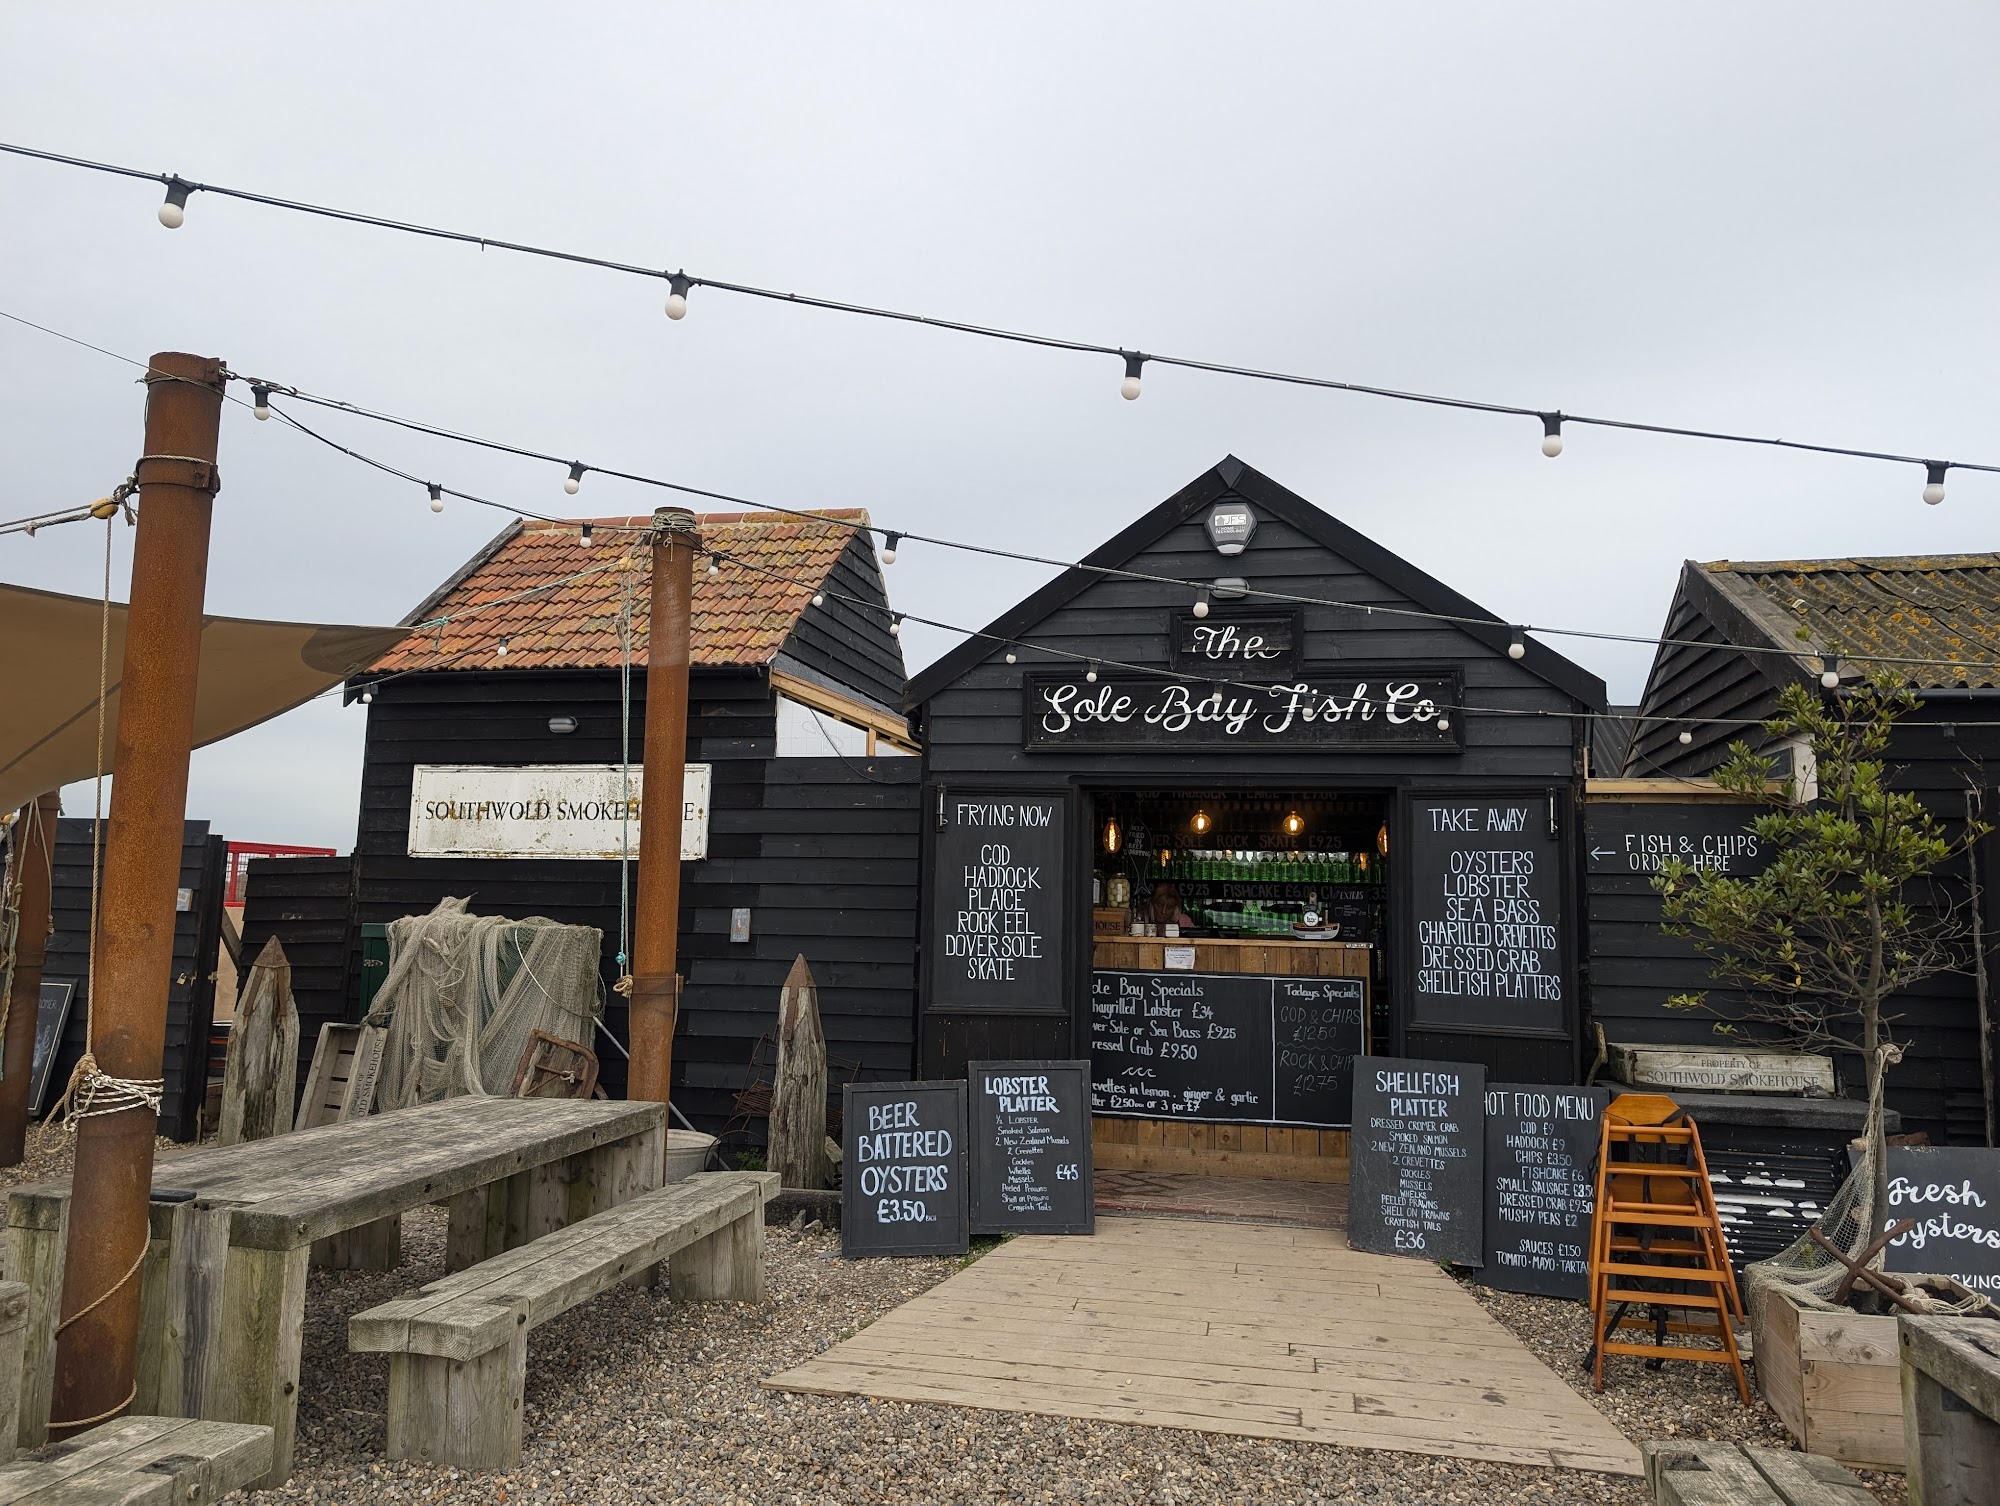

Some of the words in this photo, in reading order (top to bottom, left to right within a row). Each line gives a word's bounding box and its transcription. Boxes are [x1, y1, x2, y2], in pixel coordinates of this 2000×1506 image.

[1225, 516, 1246, 524] JFS
[1192, 626, 1281, 659] The
[1042, 684, 1138, 734] Sole
[1145, 685, 1256, 735] Bay
[1264, 682, 1377, 733] Fish
[426, 801, 550, 820] SOUTHWOLD
[557, 801, 694, 821] SMOKEHE
[957, 804, 1014, 826] FRYING
[1019, 806, 1052, 826] NOW
[1428, 808, 1479, 832] TAKE
[1486, 808, 1528, 832] AWAY
[1174, 834, 1204, 848] SOLE
[1216, 835, 1248, 848] ROCK
[1260, 835, 1298, 848] SKATE
[1625, 834, 1672, 853] FISH
[1680, 836, 1694, 853] &
[1703, 835, 1758, 856] CHIPS
[981, 844, 1010, 866] COD
[1450, 851, 1534, 874] OYSTERS
[1693, 854, 1730, 872] HERE
[964, 866, 1041, 889] HADDOCK
[1444, 874, 1530, 898] LOBSTER
[968, 888, 1026, 910] PLAICE
[1223, 884, 1281, 898] FISHCAKE
[1446, 898, 1486, 922] SEA
[1494, 899, 1540, 924] BASS
[957, 911, 999, 933] ROCK
[1004, 912, 1035, 935] EEL
[1419, 921, 1491, 946] CHARILLED
[1494, 924, 1556, 950] CREVETTES
[945, 934, 998, 956] DOVER
[1002, 936, 1042, 958] SOLE
[1422, 945, 1494, 972] DRESSED
[1497, 950, 1541, 973] CRAB
[967, 958, 1016, 980] SKATE
[1120, 977, 1144, 1000] Bay
[1151, 978, 1204, 1006] Specials
[1284, 984, 1320, 1000] Todays
[1322, 984, 1360, 1002] Specials
[1418, 970, 1490, 996] SHELLFISH
[1495, 973, 1561, 1000] PLATTERS
[1144, 999, 1183, 1018] Lobster
[1192, 1002, 1214, 1020] £34
[1280, 1006, 1306, 1023] COD
[1310, 1010, 1318, 1024] &
[1322, 1008, 1360, 1024] CHIPS
[1110, 1020, 1130, 1034] Sole
[1134, 1026, 1146, 1036] or
[1149, 1020, 1168, 1037] Sea
[1172, 1021, 1201, 1038] Bass
[1092, 1036, 1124, 1052] ressed
[1130, 1037, 1154, 1056] Crab
[1160, 1042, 1198, 1060] £9.50
[364, 1036, 384, 1097] SMOKEHOUSE
[1280, 1050, 1317, 1070] ROCK
[1320, 1055, 1329, 1072] &
[1330, 1054, 1354, 1070] CHIP
[1701, 1060, 1746, 1068] PROPERTY
[1749, 1061, 1761, 1069] OF
[985, 1076, 1050, 1094] LOBSTER
[1376, 1070, 1460, 1096] SHELLFISH
[1646, 1071, 1726, 1084] SOUTHWOLD
[1730, 1074, 1818, 1088] SMOKEHOUSE
[1130, 1084, 1139, 1095] in
[1183, 1087, 1212, 1102] ginger
[1215, 1088, 1226, 1102] &
[1230, 1091, 1258, 1106] garlic
[999, 1096, 1060, 1113] PLATTER
[1147, 1099, 1157, 1108] or
[1161, 1100, 1168, 1111] 3
[1172, 1102, 1186, 1113] for
[1390, 1098, 1448, 1118] PLATTER
[1515, 1092, 1550, 1118] FOOD
[1555, 1095, 1594, 1120] MENU
[868, 1101, 920, 1132] BEER
[1370, 1118, 1404, 1130] DRESSED
[1408, 1120, 1436, 1132] CROMER
[1440, 1122, 1460, 1132] CRAB
[998, 1126, 1023, 1136] Smoked
[1027, 1126, 1050, 1134] Salmon
[1389, 1131, 1418, 1143] SMOKED
[1423, 1134, 1448, 1144] SALMON
[1520, 1121, 1536, 1134] COD
[1543, 1122, 1554, 1136] £9
[858, 1130, 952, 1162] BATTERED
[996, 1137, 1002, 1146] 2
[1004, 1138, 1018, 1146] New
[1020, 1136, 1046, 1145] Zealand
[1046, 1136, 1070, 1144] Mussels
[1371, 1141, 1378, 1152] 2
[1378, 1142, 1395, 1152] NEW
[1399, 1142, 1432, 1156] ZEALAND
[1434, 1146, 1467, 1158] MUSSELS
[1506, 1135, 1548, 1150] HADDOCK
[1552, 1138, 1566, 1152] £9
[1015, 1146, 1044, 1155] Crevettes
[1516, 1150, 1542, 1164] CHIPS
[1547, 1152, 1572, 1166] £3.50
[1012, 1157, 1034, 1166] Cockles
[1392, 1156, 1400, 1166] 2
[1402, 1156, 1446, 1170] CREVETTES
[860, 1164, 948, 1196] OYSTERS
[1008, 1176, 1034, 1184] Mussels
[1056, 1164, 1079, 1180] £45
[1400, 1168, 1431, 1180] COCKLES
[1522, 1166, 1568, 1180] FISHCAKE
[1572, 1170, 1584, 1182] £6
[1002, 1183, 1020, 1192] Peeled
[1024, 1183, 1048, 1192] Prawns
[1400, 1179, 1432, 1191] MUSSELS
[1496, 1177, 1529, 1192] SMALL
[1532, 1180, 1570, 1196] SAUSAGE
[1888, 1177, 1986, 1208] Fresh
[1002, 1193, 1018, 1203] Shell
[1381, 1194, 1406, 1206] PEELED
[1409, 1198, 1438, 1210] PRAWNS
[1400, 1189, 1426, 1200] WHELKS
[1500, 1192, 1544, 1208] DRESSED
[1546, 1196, 1566, 1210] CRAB
[1569, 1199, 1593, 1214] £9.50
[877, 1198, 926, 1223] £3.50
[1008, 1202, 1034, 1212] Crayfish
[1036, 1202, 1052, 1211] Tails
[1381, 1205, 1404, 1216] SHELL
[1406, 1208, 1418, 1218] ON
[1422, 1210, 1450, 1220] PRAWNS
[1384, 1217, 1420, 1229] CRAYFISH
[1423, 1221, 1442, 1232] TAILS
[1498, 1207, 1535, 1224] MUSHY
[1538, 1211, 1560, 1226] PEAS
[1565, 1214, 1578, 1226] £2
[1394, 1230, 1426, 1250] £36
[1520, 1239, 1554, 1256] SAUCES
[1558, 1244, 1582, 1257] £1.50
[1496, 1250, 1528, 1268] TOMATO
